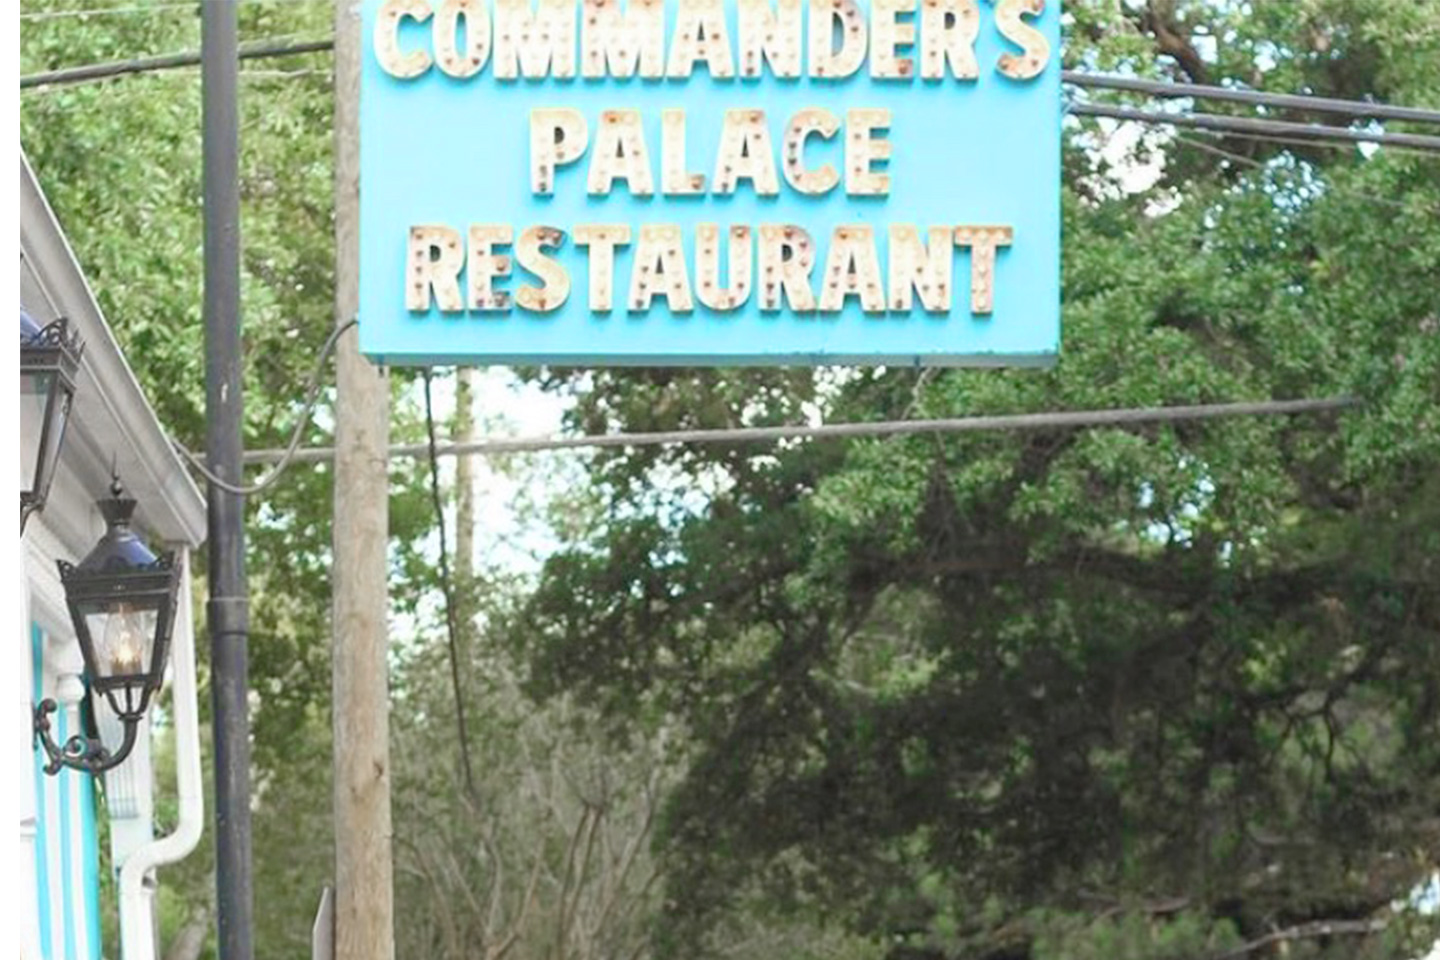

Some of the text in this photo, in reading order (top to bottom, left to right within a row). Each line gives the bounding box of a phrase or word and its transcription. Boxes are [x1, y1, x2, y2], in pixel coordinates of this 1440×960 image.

[373, 0, 1051, 80] COMMANDERS
[529, 108, 892, 196] PALACE
[405, 225, 1013, 315] RESTAURANT
